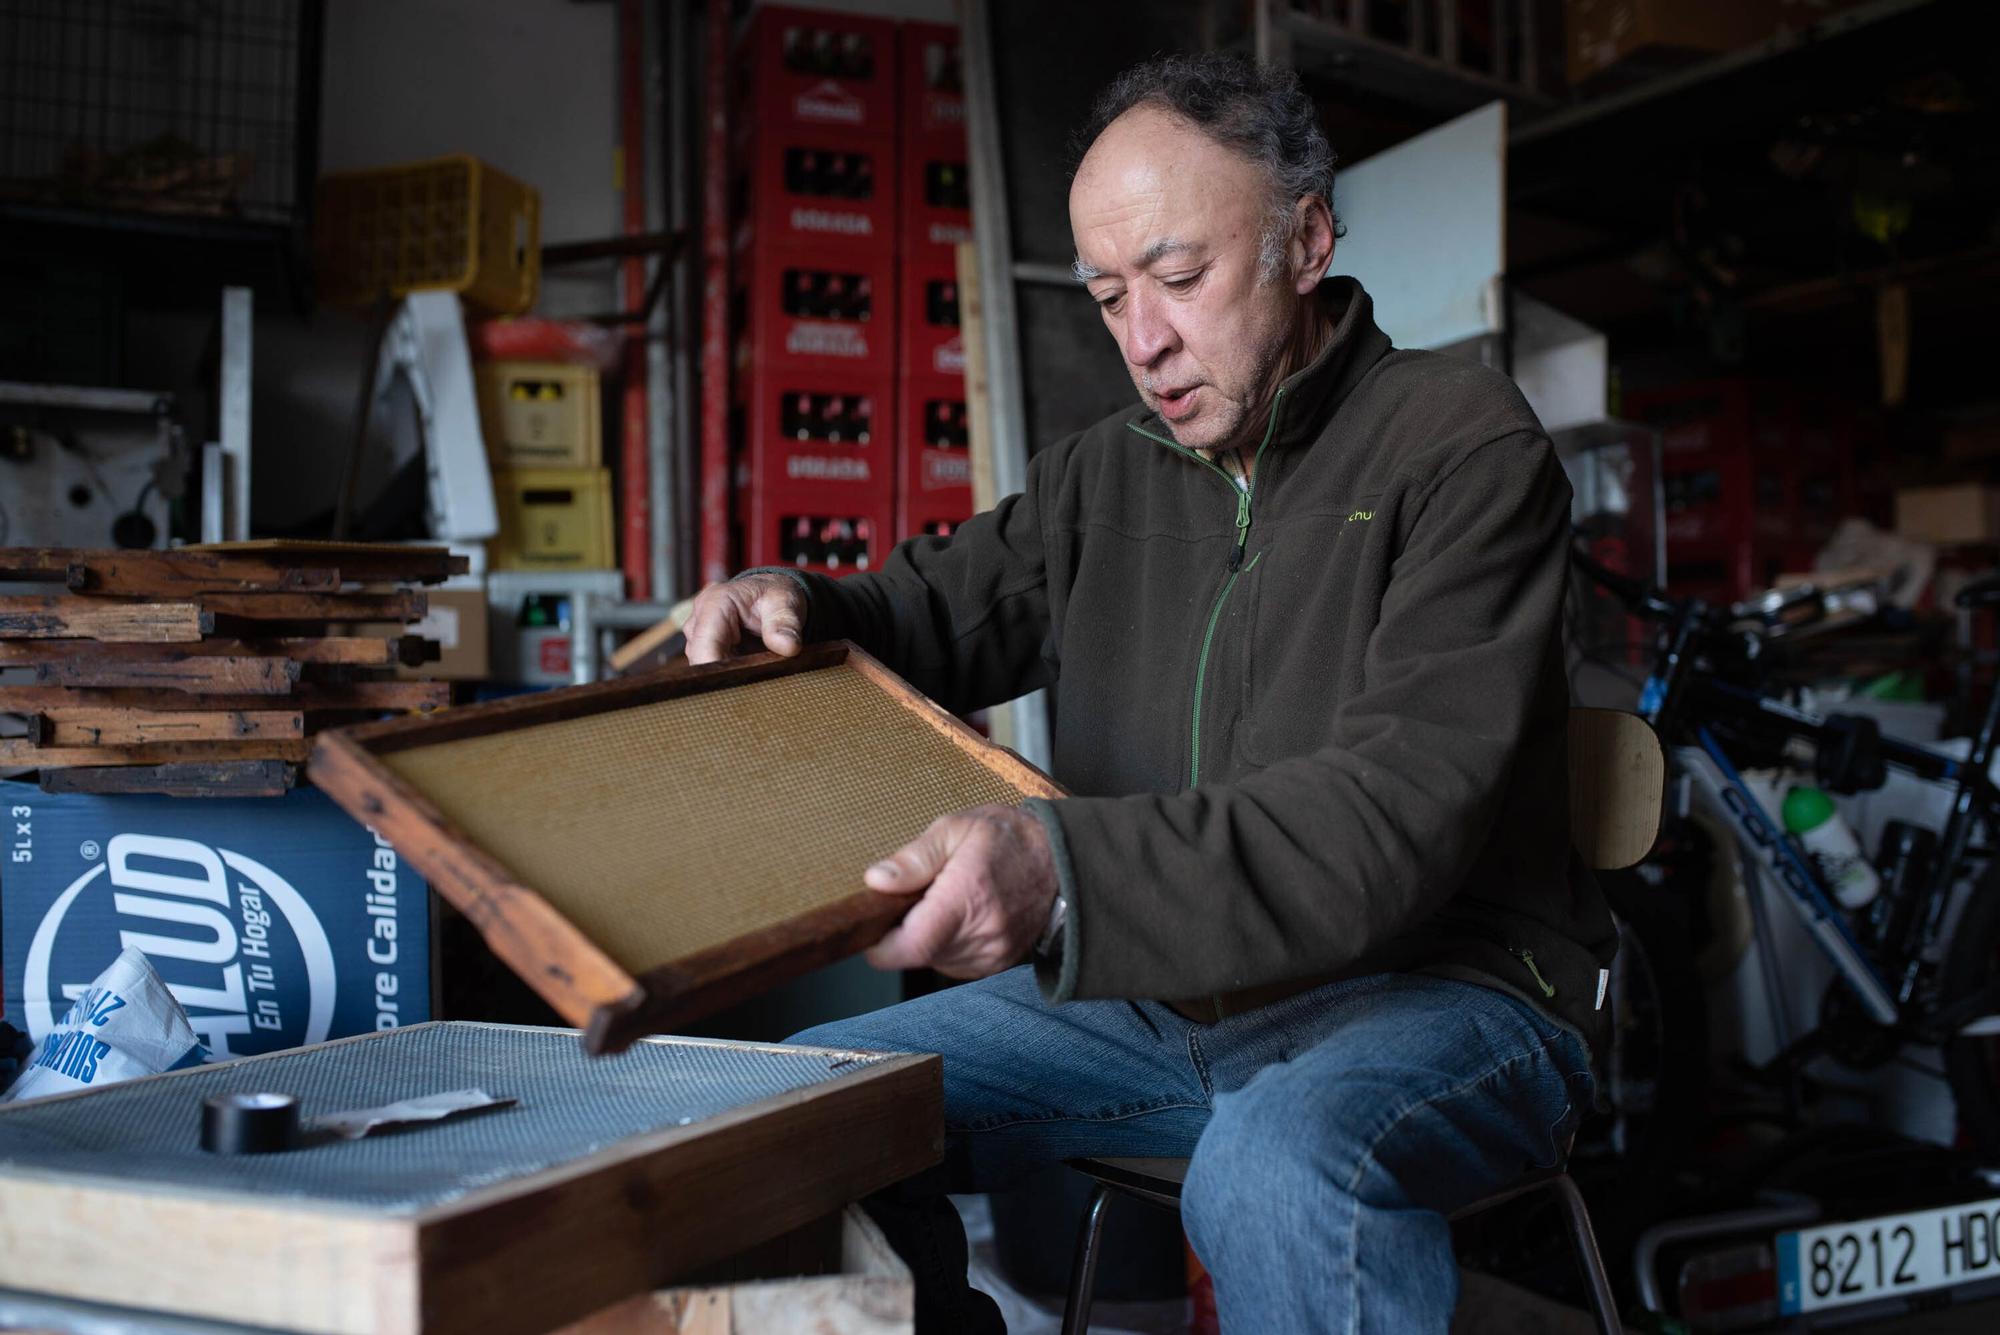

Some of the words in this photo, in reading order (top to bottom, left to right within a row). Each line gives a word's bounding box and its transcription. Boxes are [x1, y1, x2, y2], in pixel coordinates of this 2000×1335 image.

[238, 882, 271, 958] Hogar
[247, 964, 277, 992] Tu
[253, 999, 283, 1031] En
[1811, 1224, 1917, 1298] 8212
